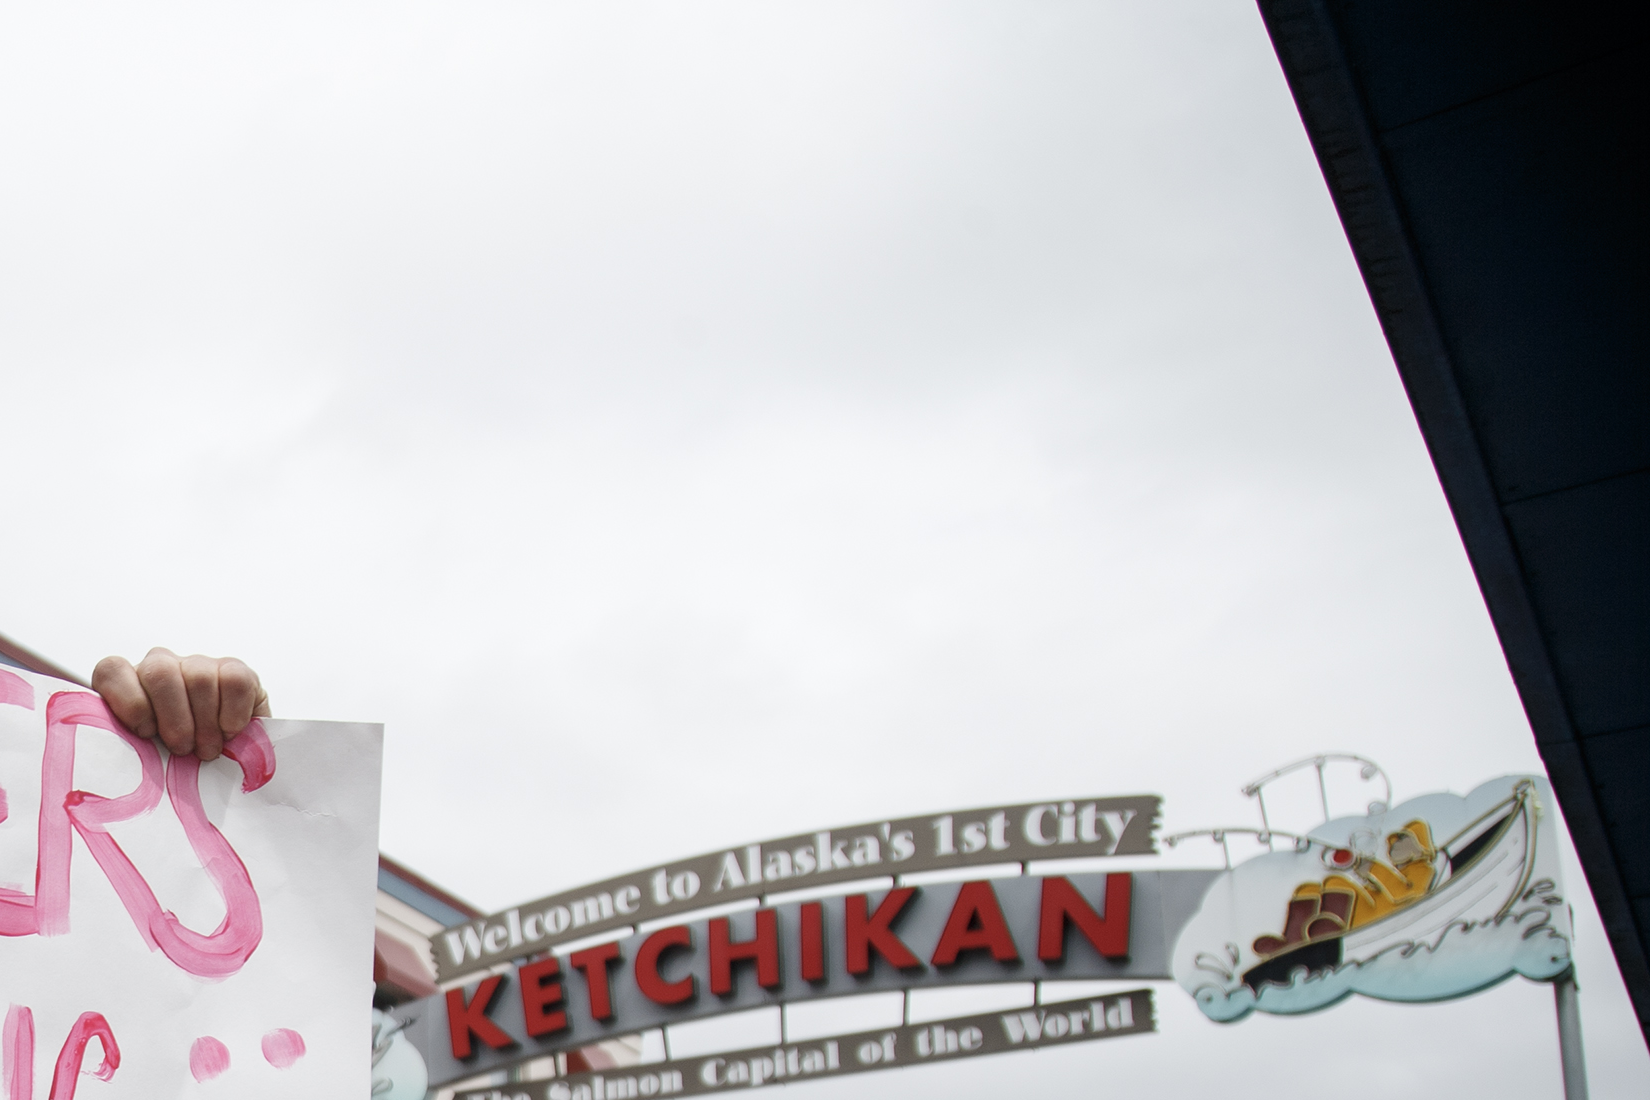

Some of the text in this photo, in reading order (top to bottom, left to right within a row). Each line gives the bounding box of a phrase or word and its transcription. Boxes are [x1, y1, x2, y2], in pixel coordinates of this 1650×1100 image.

[444, 802, 1137, 966] Welcome to Alaska's 1st City
[445, 872, 1133, 1060] KETCHIKAN
[701, 1041, 840, 1087] Capital
[857, 1032, 897, 1065] of
[916, 1025, 983, 1058] the
[1001, 998, 1135, 1044] World
